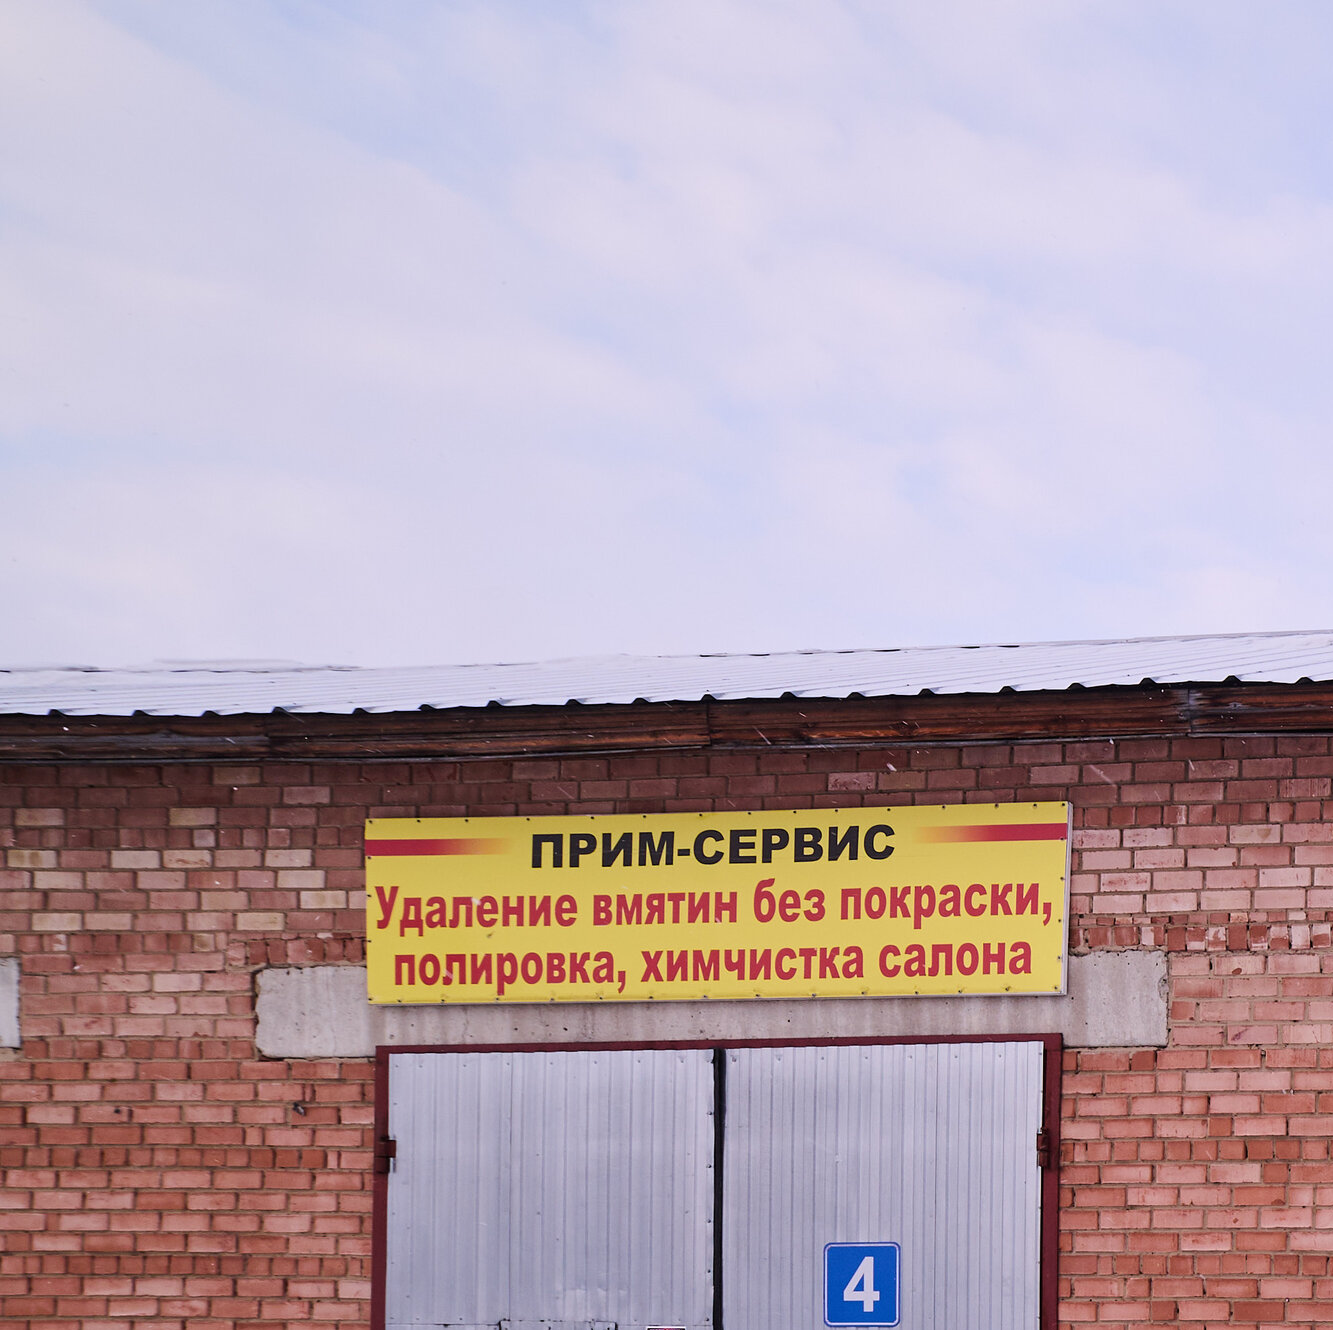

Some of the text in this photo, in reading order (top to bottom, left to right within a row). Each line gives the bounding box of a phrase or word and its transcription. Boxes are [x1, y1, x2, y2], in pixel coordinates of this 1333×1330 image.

[531, 824, 895, 869] ПРИМ-СЕРВИС
[374, 877, 1052, 938] Удаление вмятин без покраски,
[394, 941, 1032, 997] полировка, химчистка салона
[843, 1256, 881, 1313] 4
